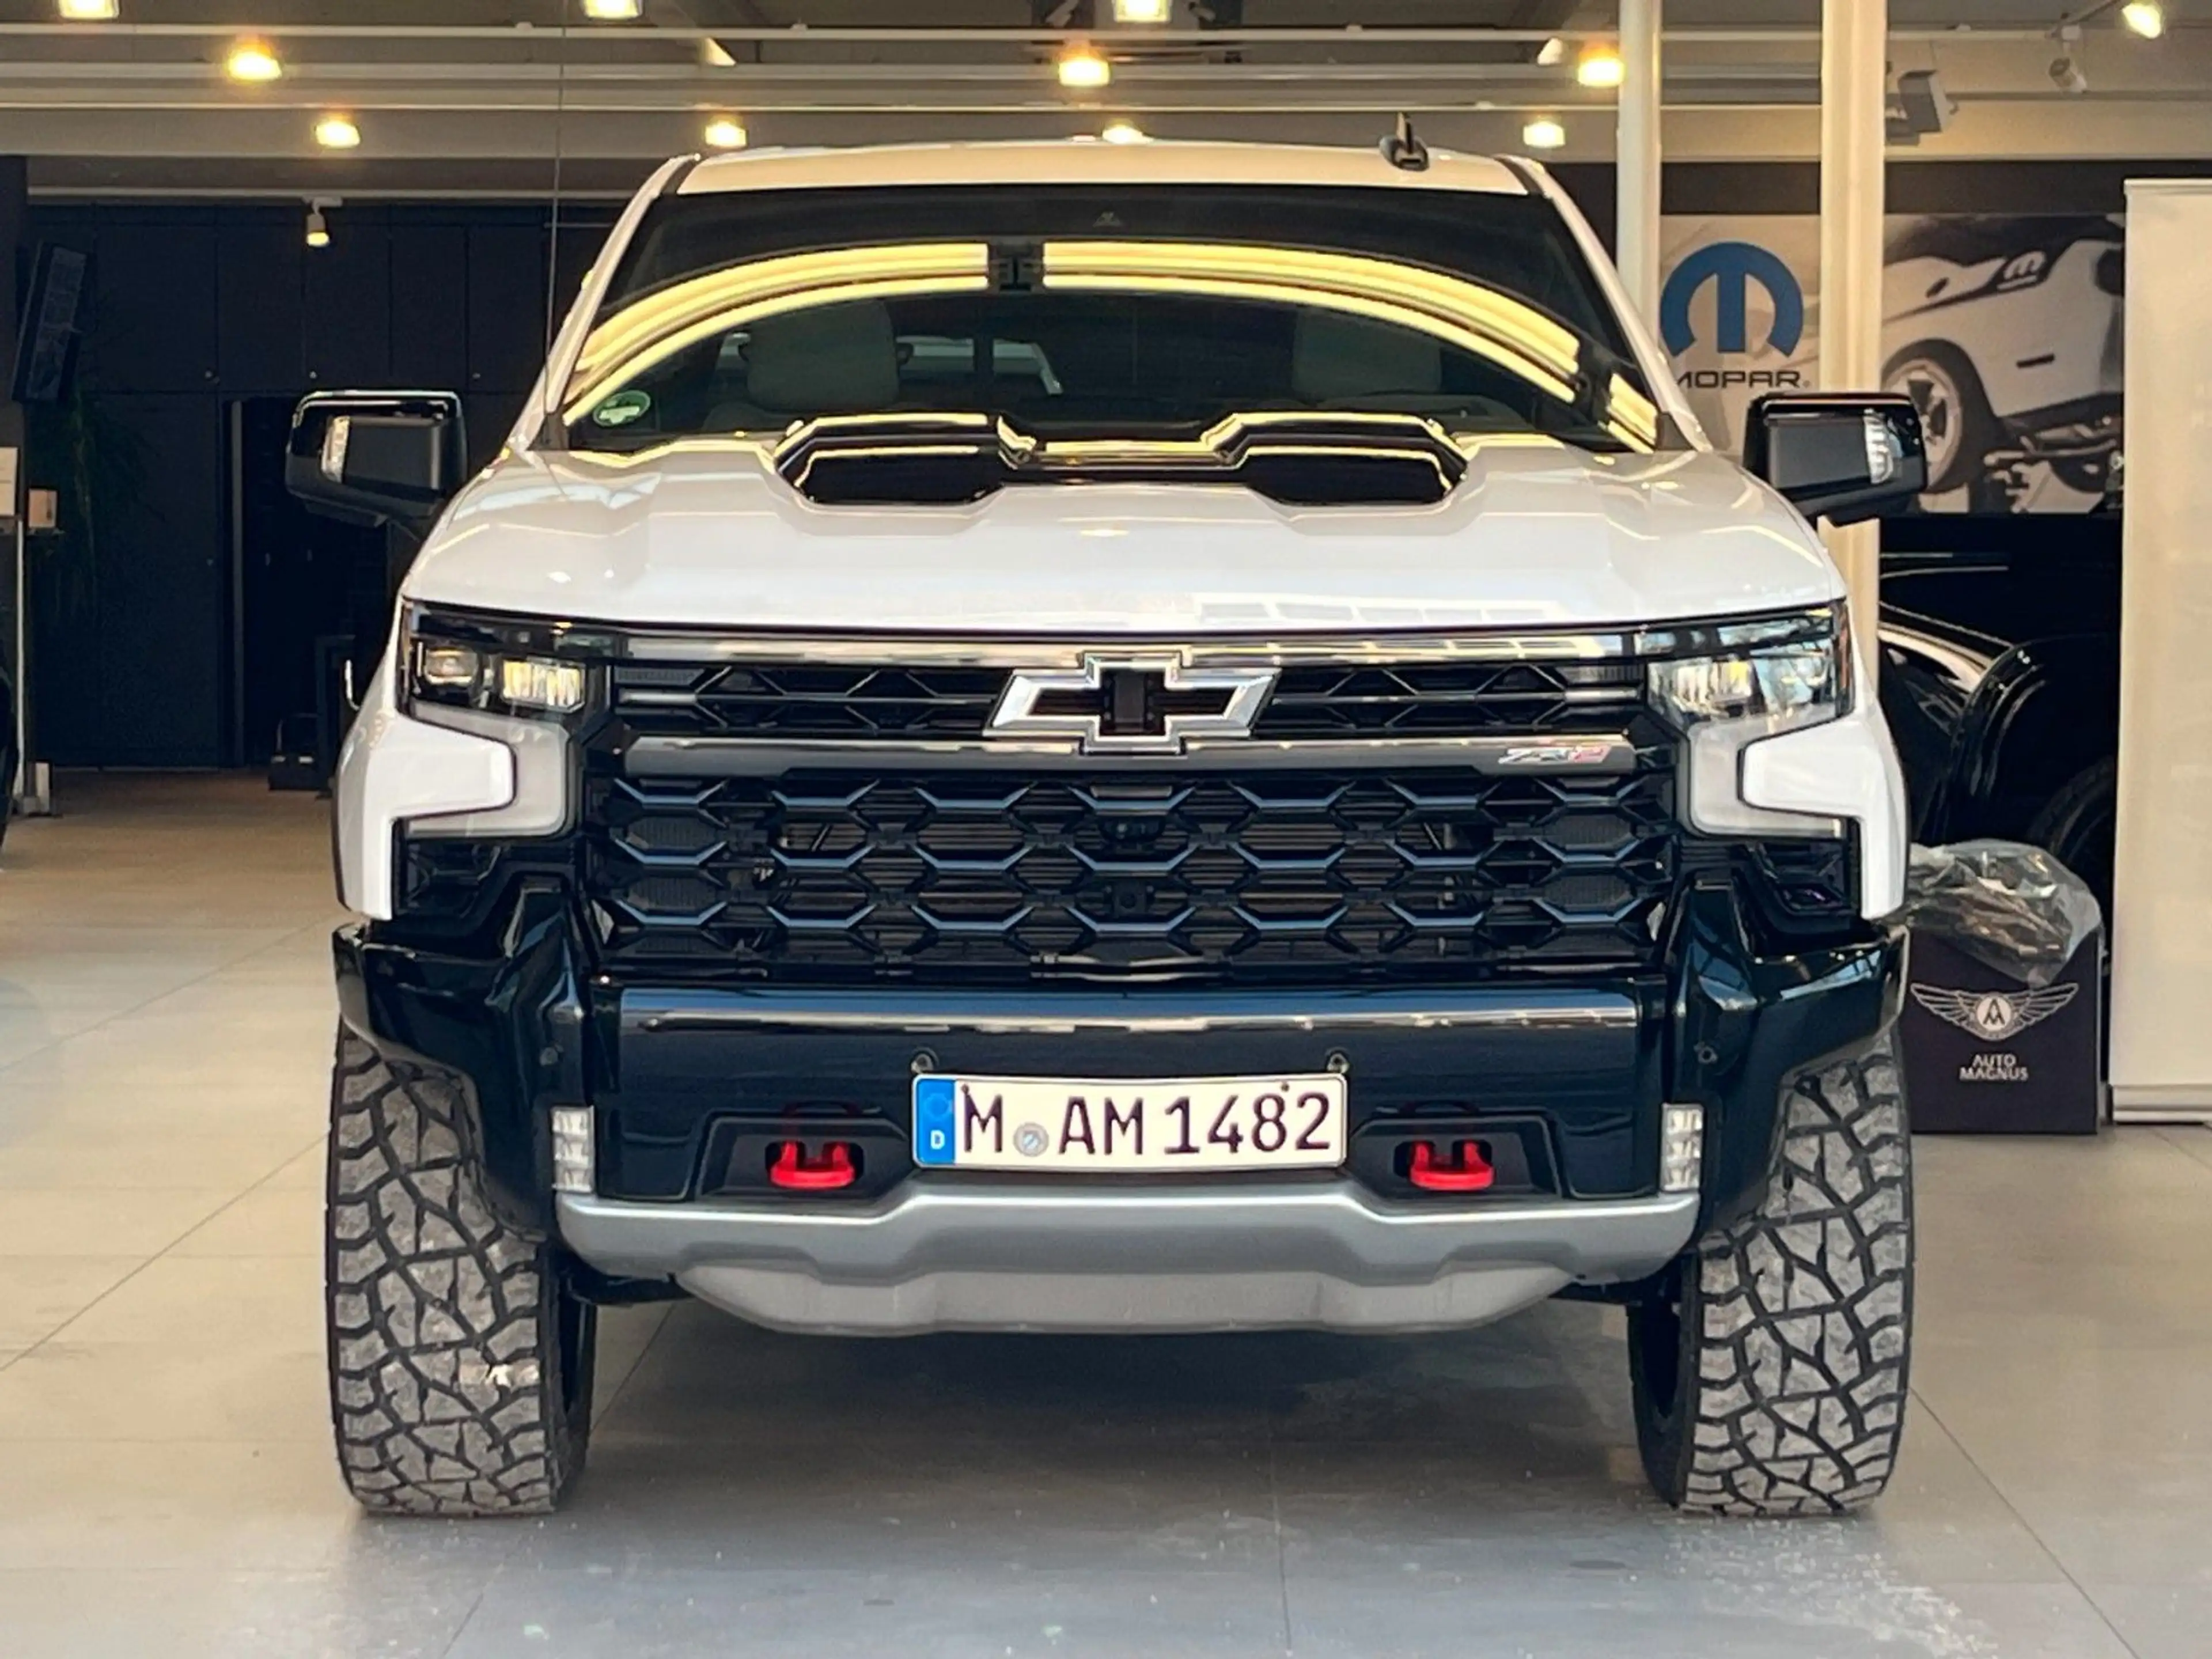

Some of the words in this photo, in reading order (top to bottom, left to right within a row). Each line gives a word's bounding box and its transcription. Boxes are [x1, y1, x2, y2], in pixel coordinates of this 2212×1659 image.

[1972, 1054, 2016, 1067] AUTO
[1960, 1067, 2029, 1081] MAGNUS
[964, 1094, 1003, 1153] M
[1058, 1096, 1143, 1155] AM
[1164, 1092, 1331, 1154] 1482
[930, 1130, 945, 1150] D
